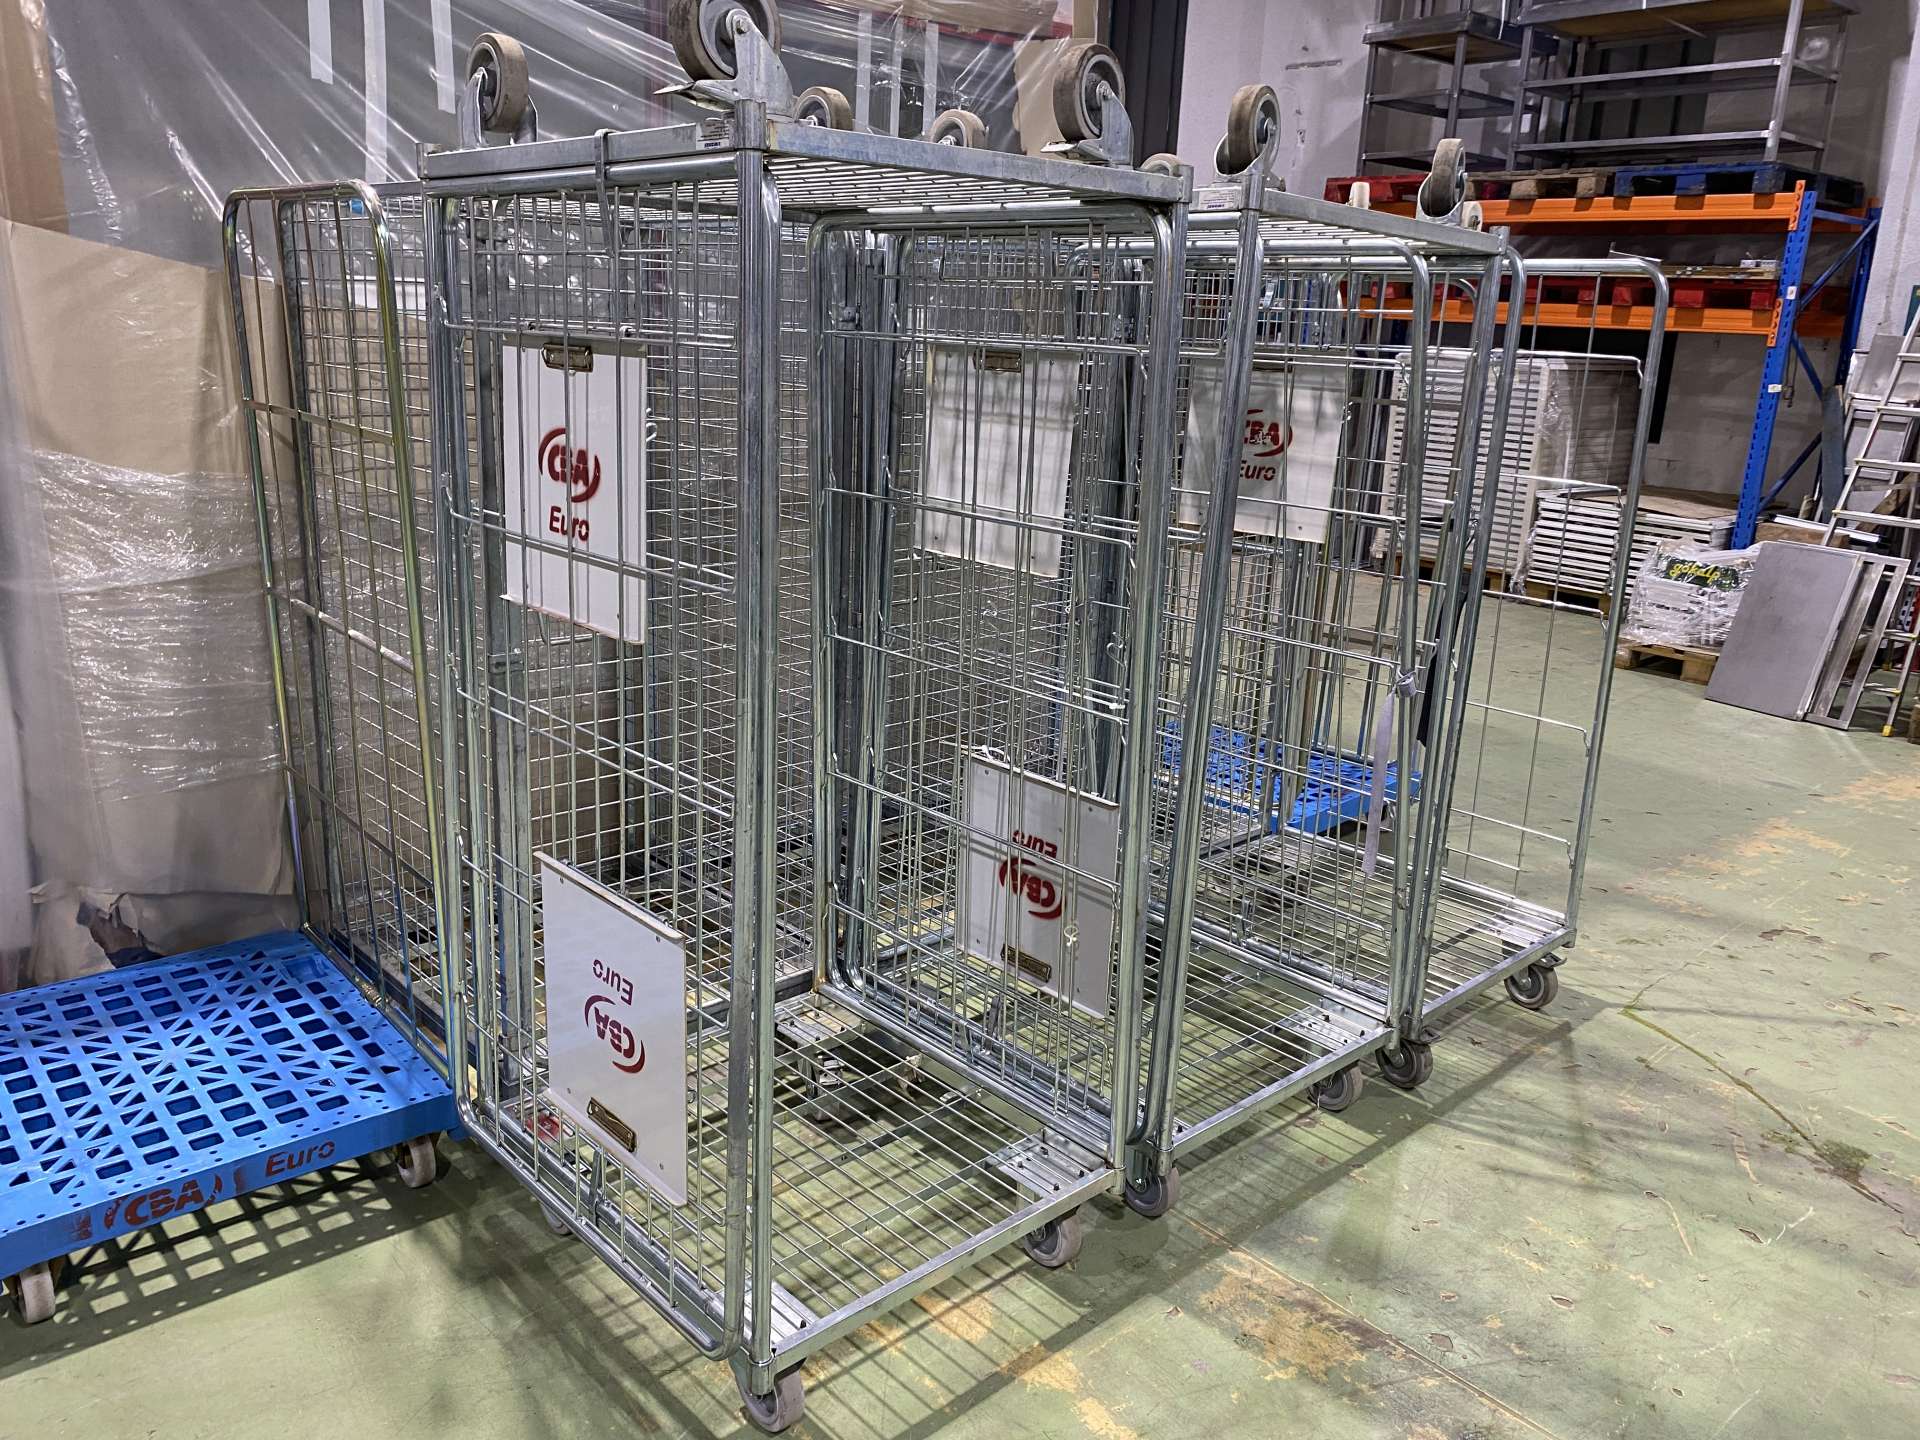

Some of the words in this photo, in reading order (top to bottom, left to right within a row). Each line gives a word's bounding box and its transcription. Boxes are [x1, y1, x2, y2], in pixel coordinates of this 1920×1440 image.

[547, 444, 589, 487] CBA
[593, 959, 634, 1006] Euro
[594, 1006, 635, 1059] CBA
[124, 1179, 206, 1227] CBA
[264, 1140, 336, 1177] Euro
